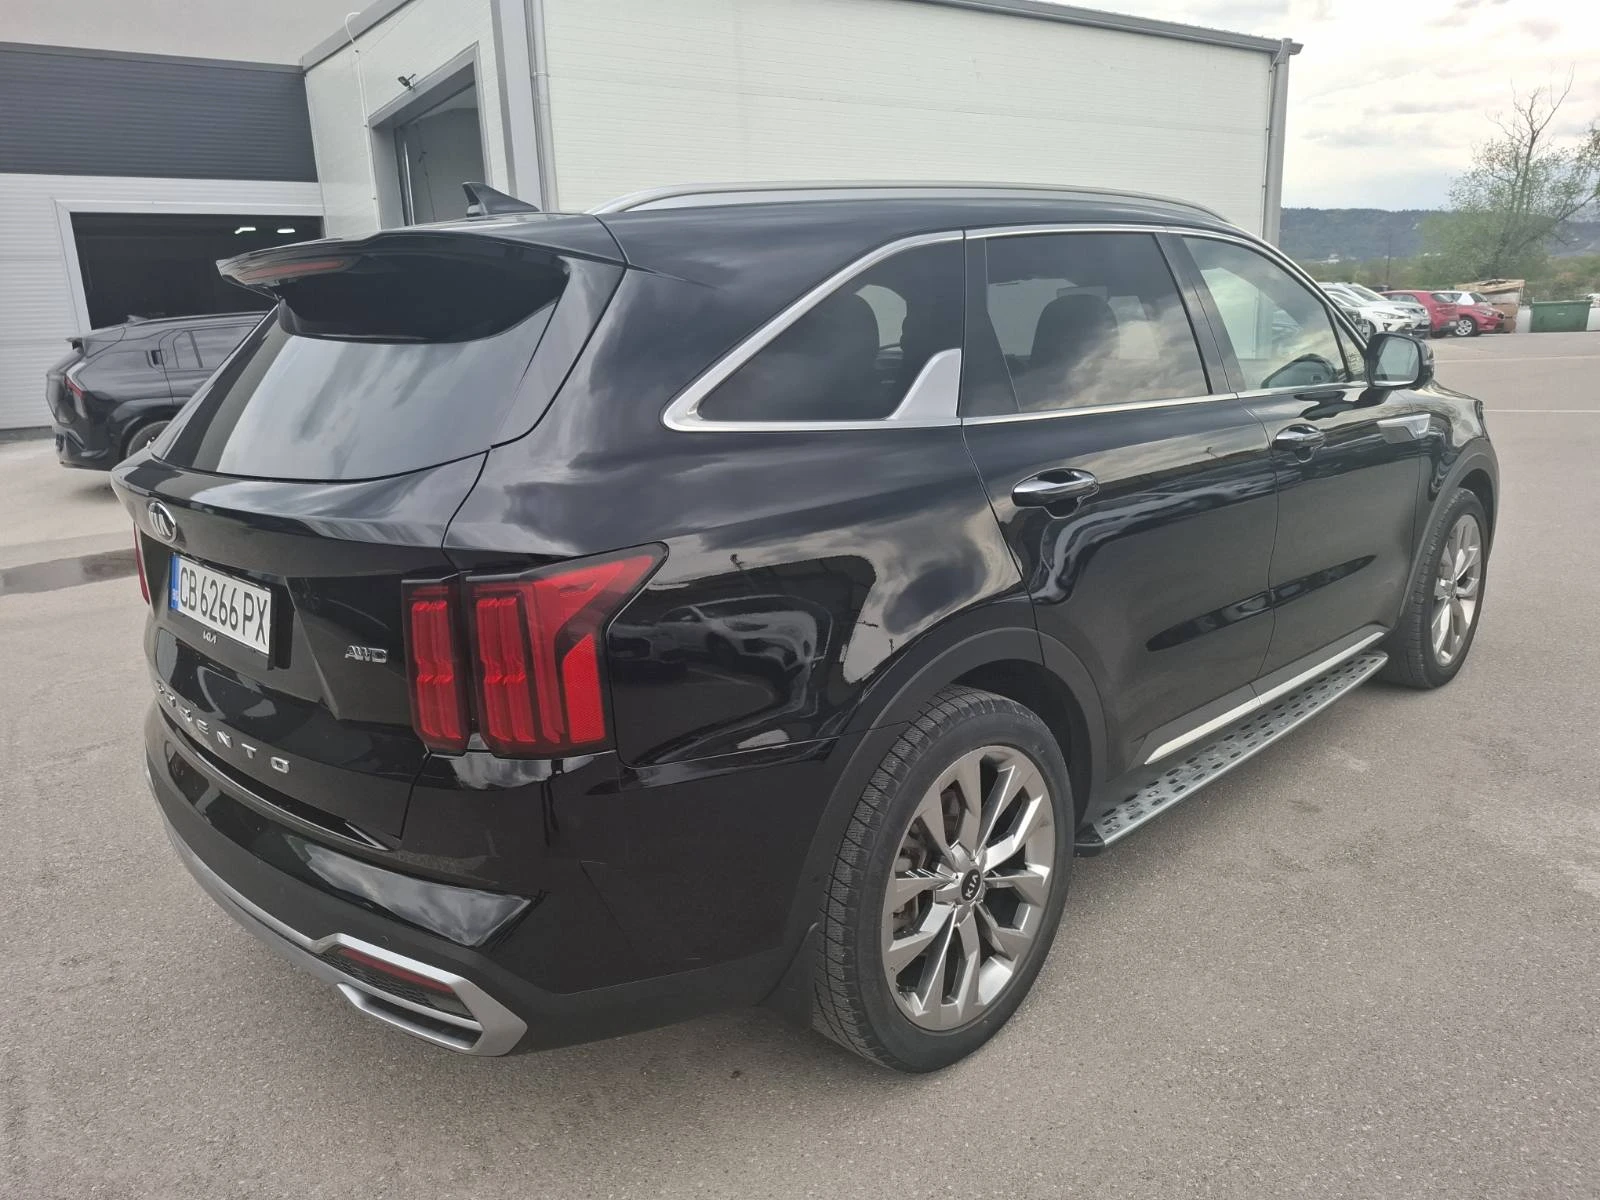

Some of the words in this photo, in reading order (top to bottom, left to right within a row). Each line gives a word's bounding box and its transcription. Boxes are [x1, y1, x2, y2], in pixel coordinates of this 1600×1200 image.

[180, 567, 197, 611] CB
[200, 575, 238, 631] 6266
[242, 591, 268, 646] PX
[344, 645, 387, 663] AWD
[965, 874, 979, 898] KIA
